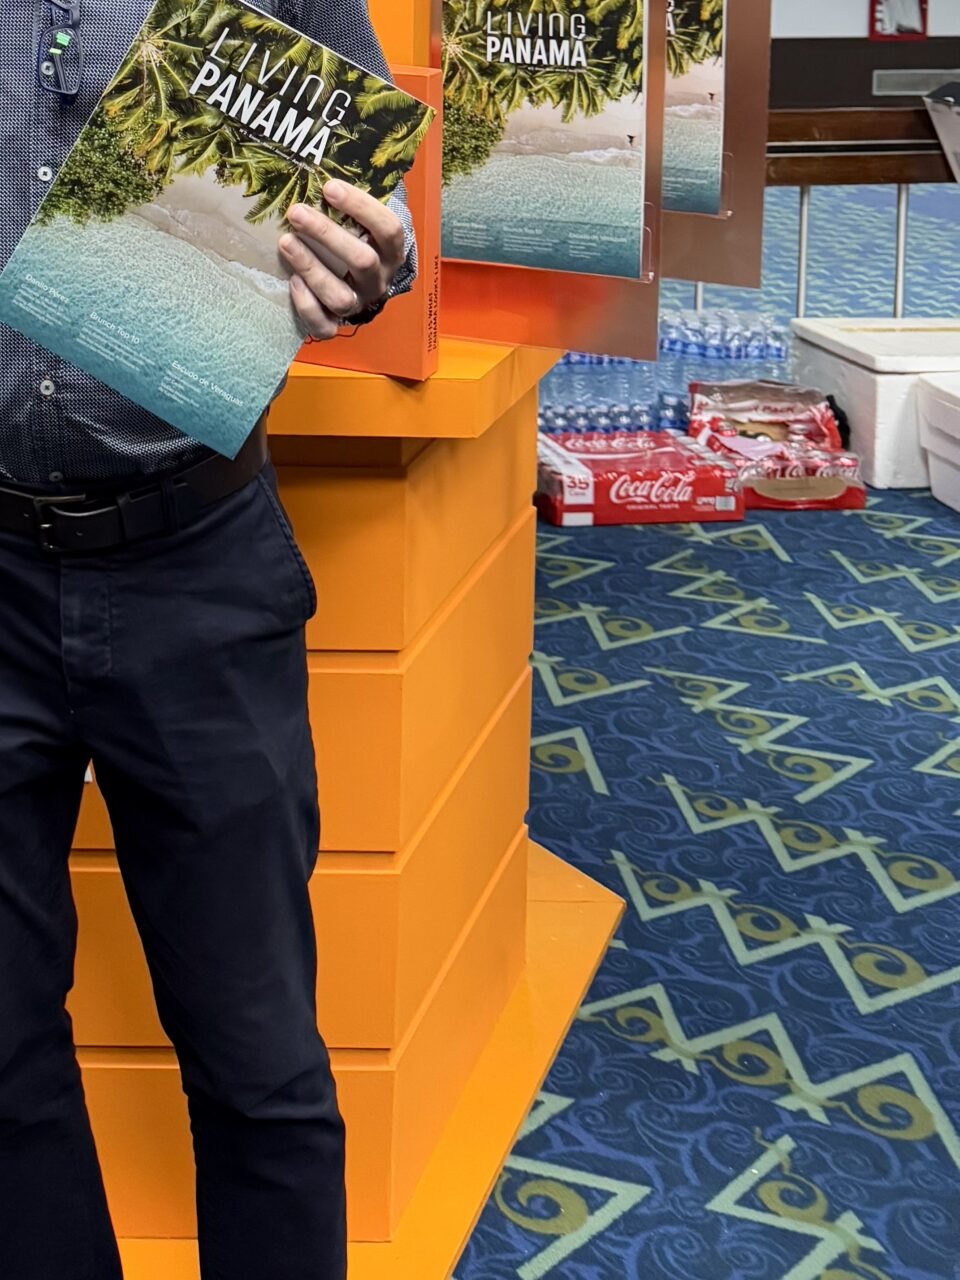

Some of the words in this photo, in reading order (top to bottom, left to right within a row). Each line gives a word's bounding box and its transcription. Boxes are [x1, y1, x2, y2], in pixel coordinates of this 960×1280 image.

[486, 10, 587, 38] LIVING
[209, 26, 353, 125] LIVING
[189, 61, 333, 166] PANAMÁ
[25, 274, 48, 290] Danilo
[90, 312, 115, 329] Brunch
[116, 327, 130, 338] Top
[130, 335, 139, 343] 10
[171, 360, 199, 379] Escudo
[199, 377, 208, 385] de
[209, 383, 243, 406] Veraguas
[567, 475, 590, 489] 35
